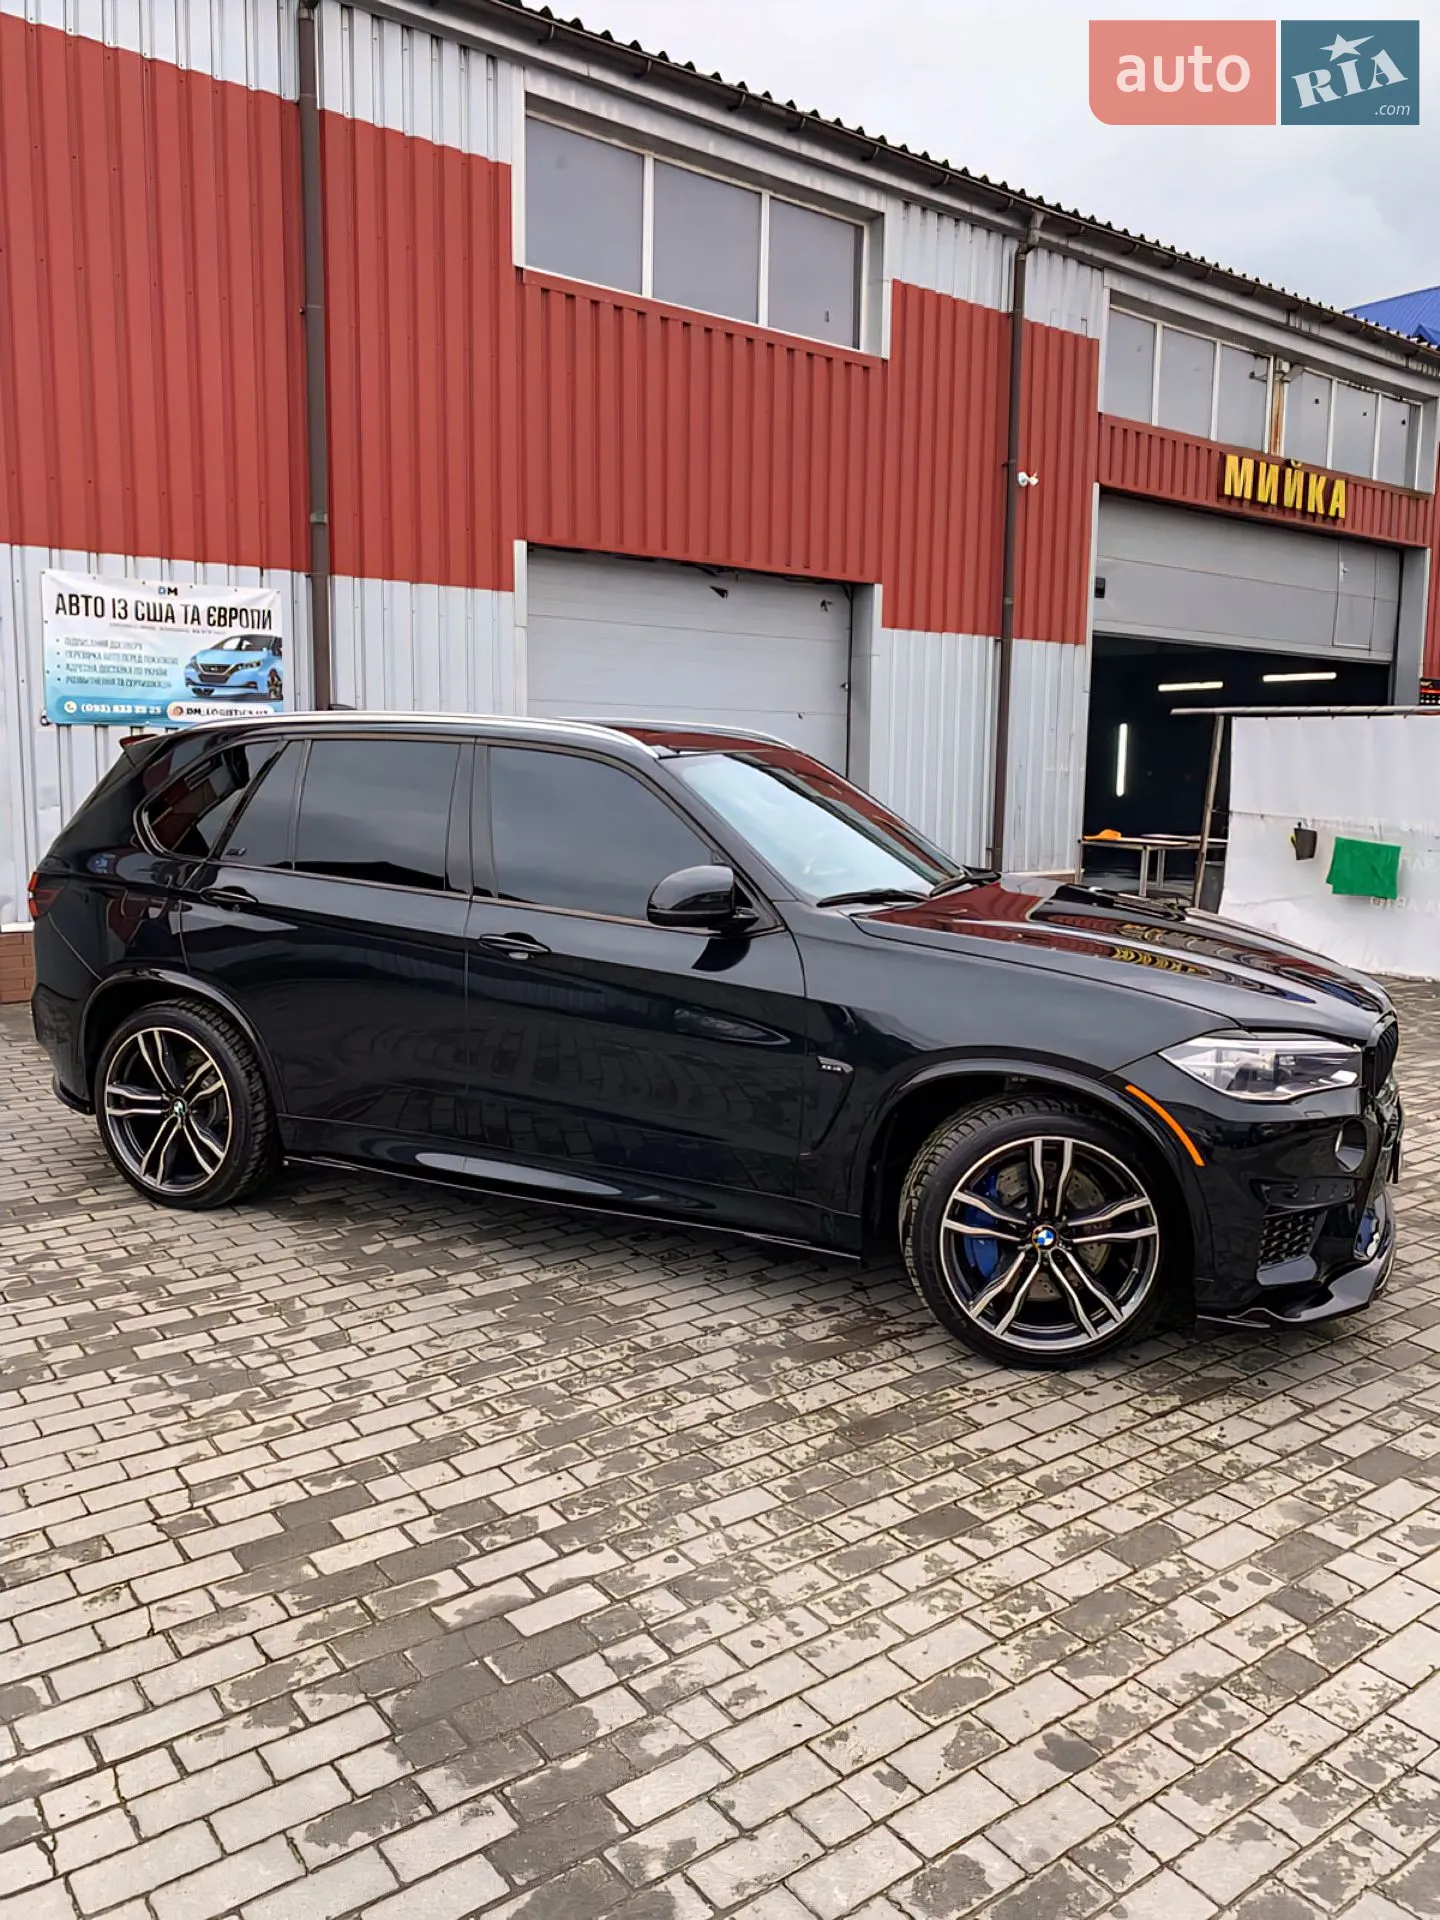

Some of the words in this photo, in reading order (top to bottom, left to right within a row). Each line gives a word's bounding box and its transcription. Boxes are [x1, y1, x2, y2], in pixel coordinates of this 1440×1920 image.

[1223, 453, 1346, 518] МИЙКА
[158, 585, 178, 596] DM
[55, 592, 105, 618] АВТО
[111, 597, 129, 620] ІЗ
[134, 599, 176, 624] США
[180, 603, 201, 626] ТА
[207, 605, 272, 630] ЄВРОПИ
